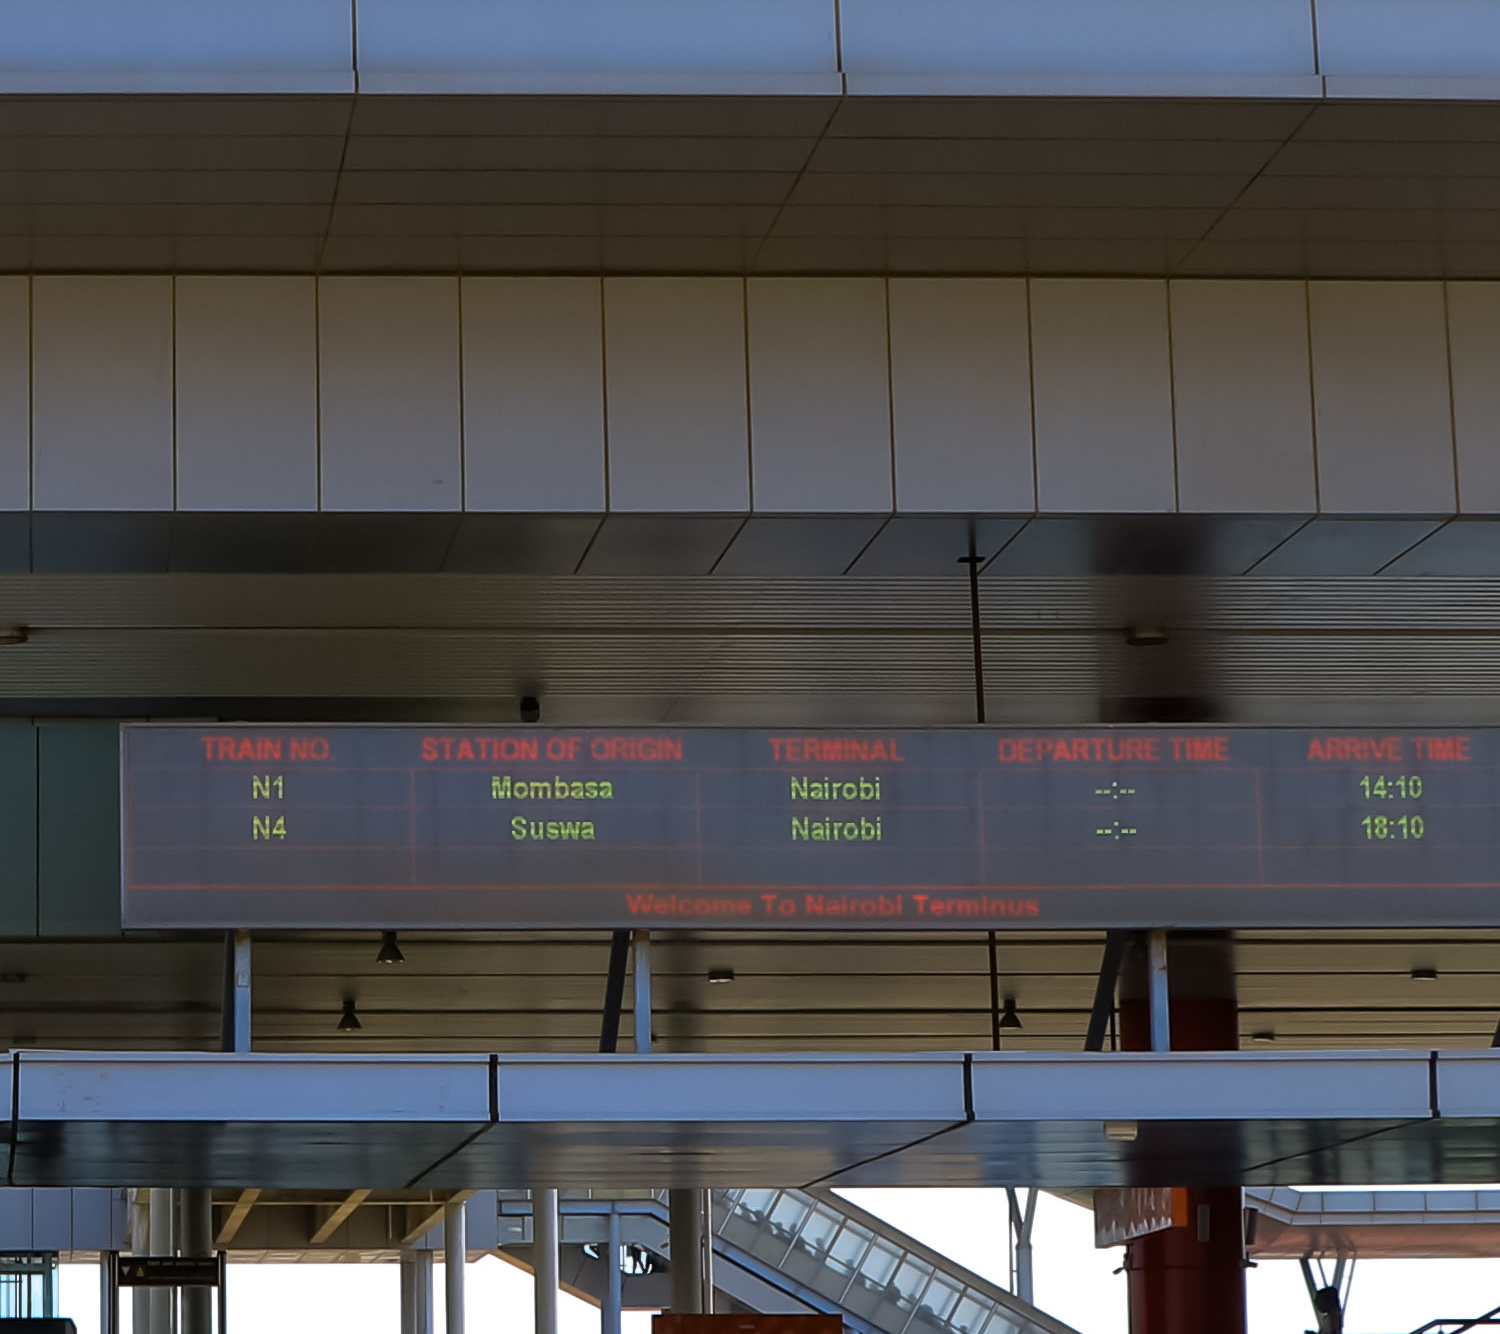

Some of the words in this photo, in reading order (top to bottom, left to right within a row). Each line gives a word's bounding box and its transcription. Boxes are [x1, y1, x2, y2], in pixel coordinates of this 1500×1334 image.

[202, 737, 282, 760] TRAIN
[290, 737, 335, 760] NO.
[421, 737, 538, 761] STATION
[547, 737, 582, 760] OF
[591, 737, 683, 761] ORIGIN
[769, 738, 905, 762] TERMINAL
[998, 738, 1160, 762] DEPARTURE
[1169, 737, 1229, 761] TIME
[1307, 737, 1403, 761] ARRIVE
[1411, 737, 1471, 761] TIME
[252, 775, 284, 799] N1
[491, 775, 614, 799] Mombasa
[791, 776, 880, 800] Nairobi
[1359, 775, 1423, 799] 14:10
[253, 815, 287, 840] N4
[511, 816, 596, 841] Suswa
[792, 816, 882, 841] Nairobi
[1362, 815, 1425, 840] 18:10
[626, 893, 752, 916] Welcome
[761, 893, 796, 916] To
[805, 893, 901, 916] Nairobi
[912, 893, 1040, 916] Terminus
